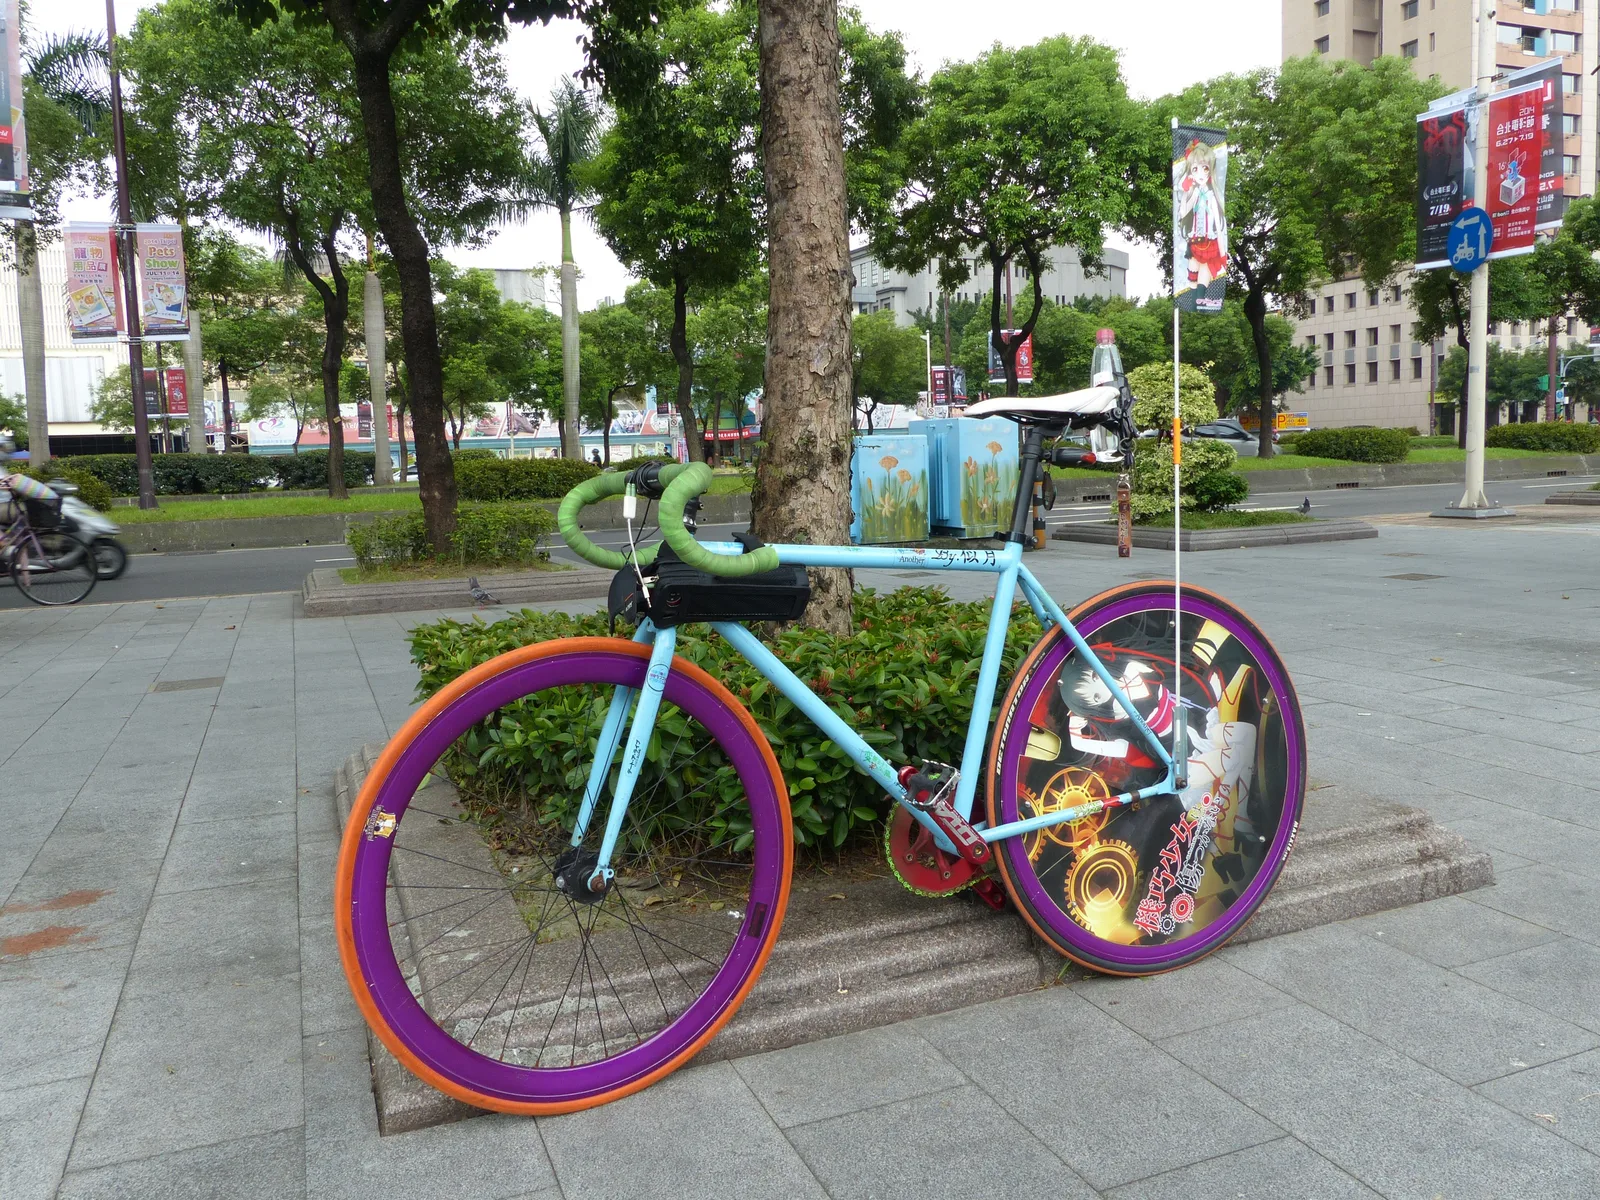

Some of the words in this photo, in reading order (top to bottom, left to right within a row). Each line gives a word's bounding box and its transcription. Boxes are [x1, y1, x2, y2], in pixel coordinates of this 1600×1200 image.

[148, 246, 176, 257] Pets
[145, 258, 179, 269] Show
[899, 555, 925, 565] Another
